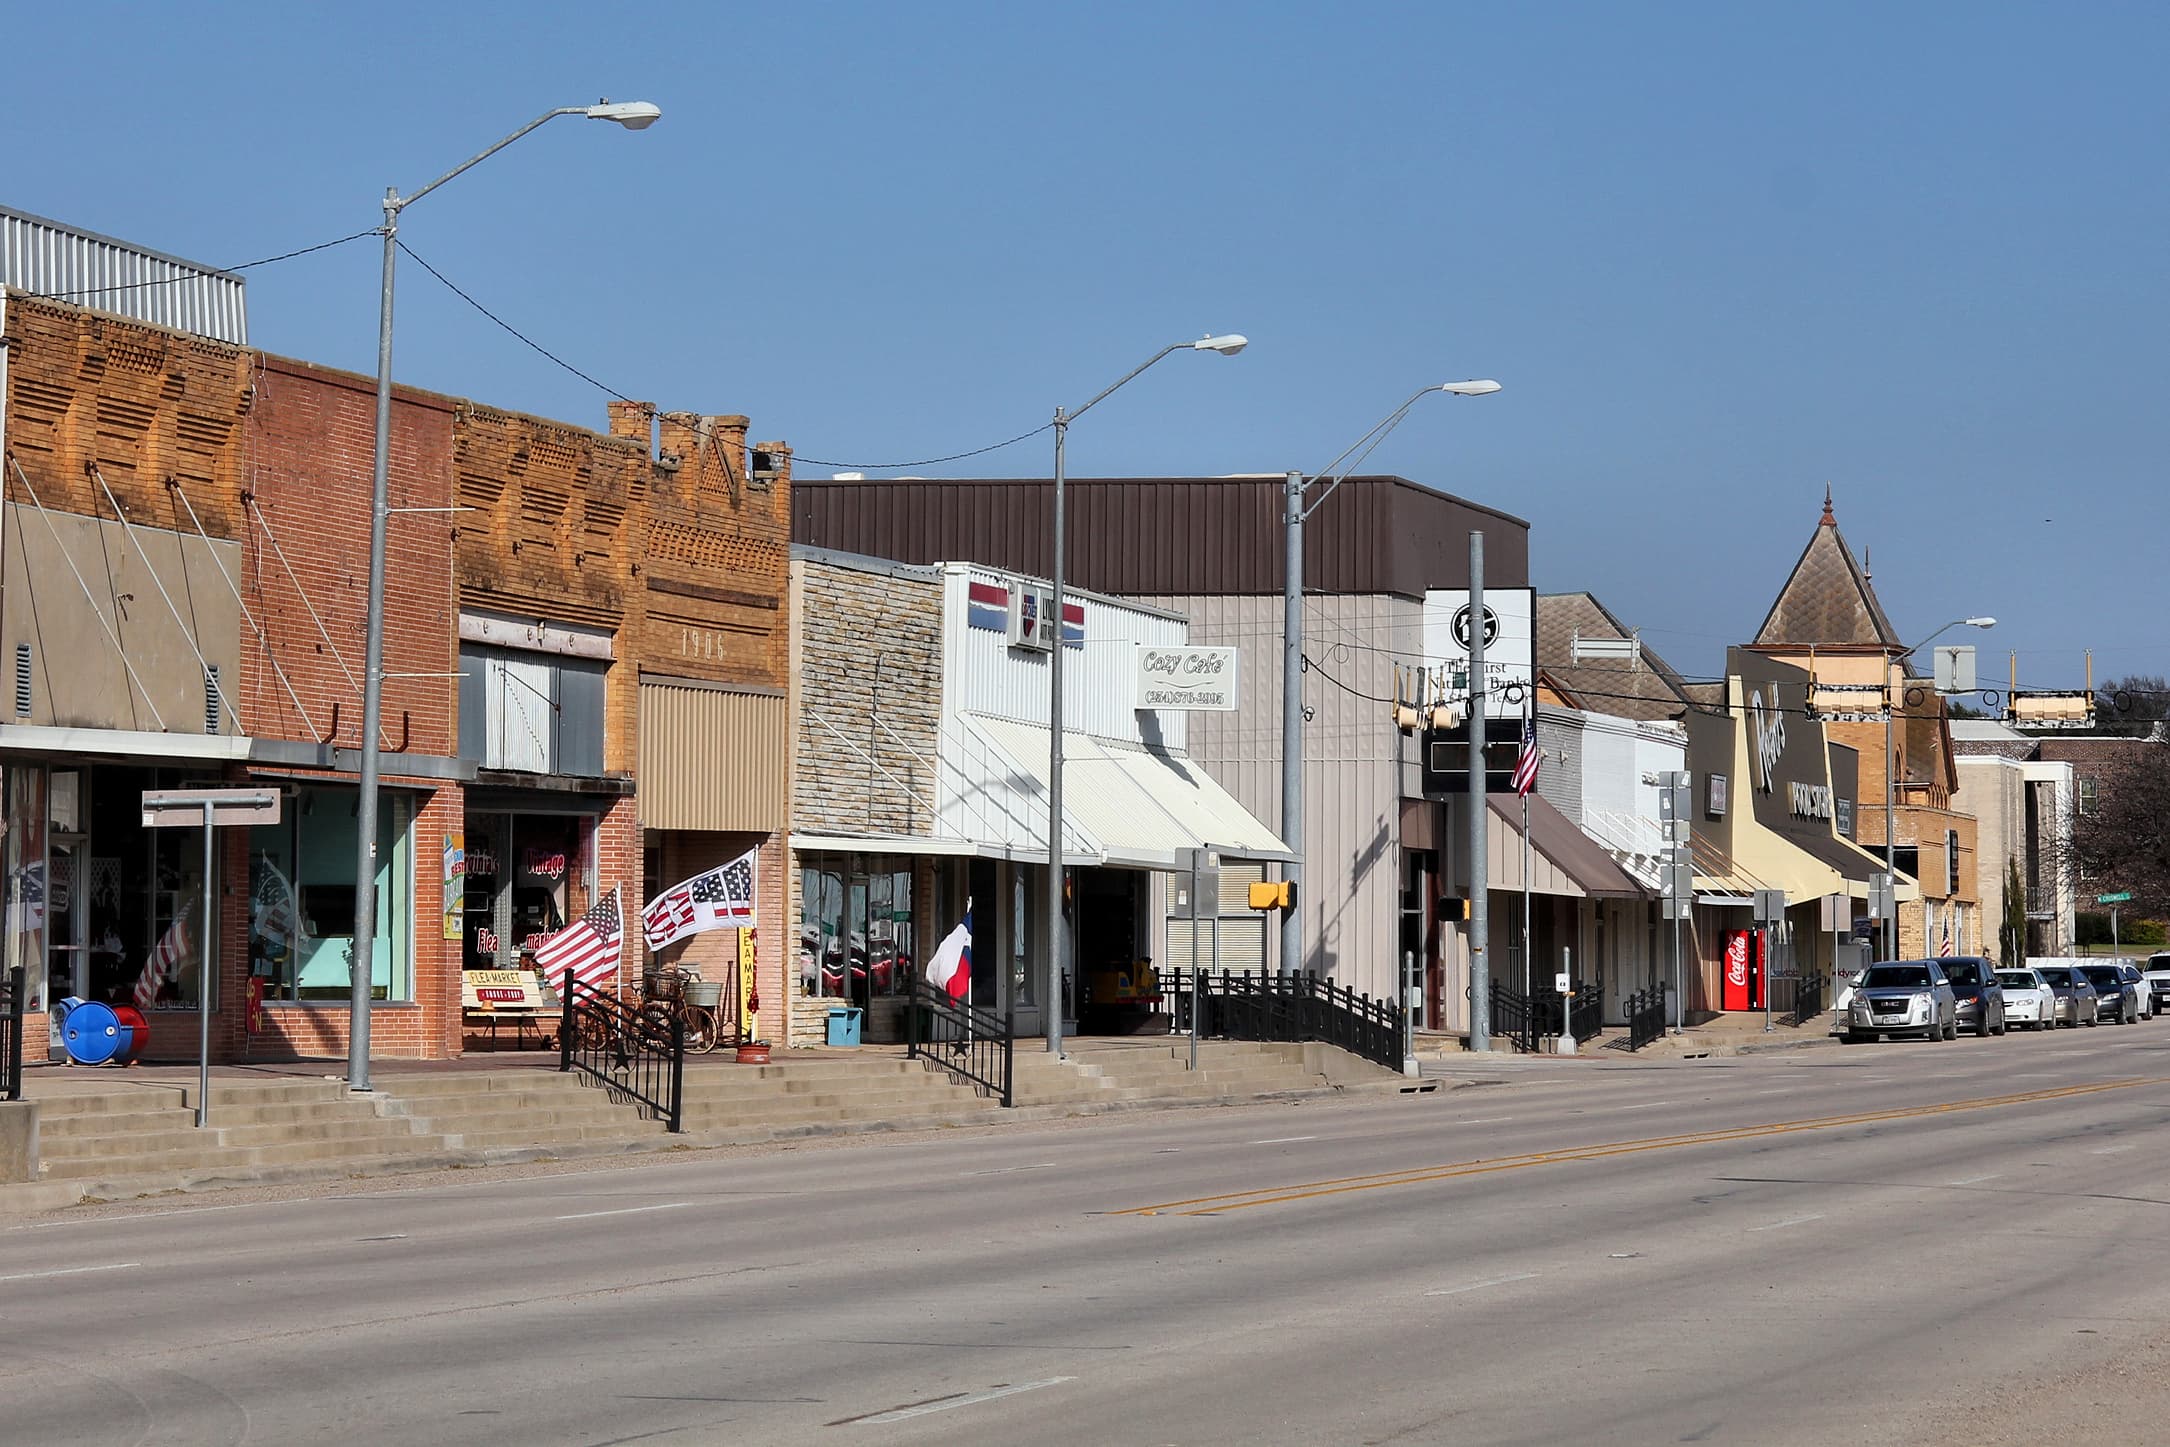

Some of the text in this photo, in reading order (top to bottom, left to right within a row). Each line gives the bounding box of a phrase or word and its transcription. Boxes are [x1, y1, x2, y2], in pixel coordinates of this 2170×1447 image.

[682, 627, 724, 661] 1906
[1143, 651, 1228, 675] Cozy Café
[1484, 661, 1507, 673] irst
[527, 851, 565, 880] Vintage
[477, 927, 499, 954] Flea
[1727, 934, 1746, 987] Coca-Cola
[470, 972, 521, 984] FLEA MARKET
